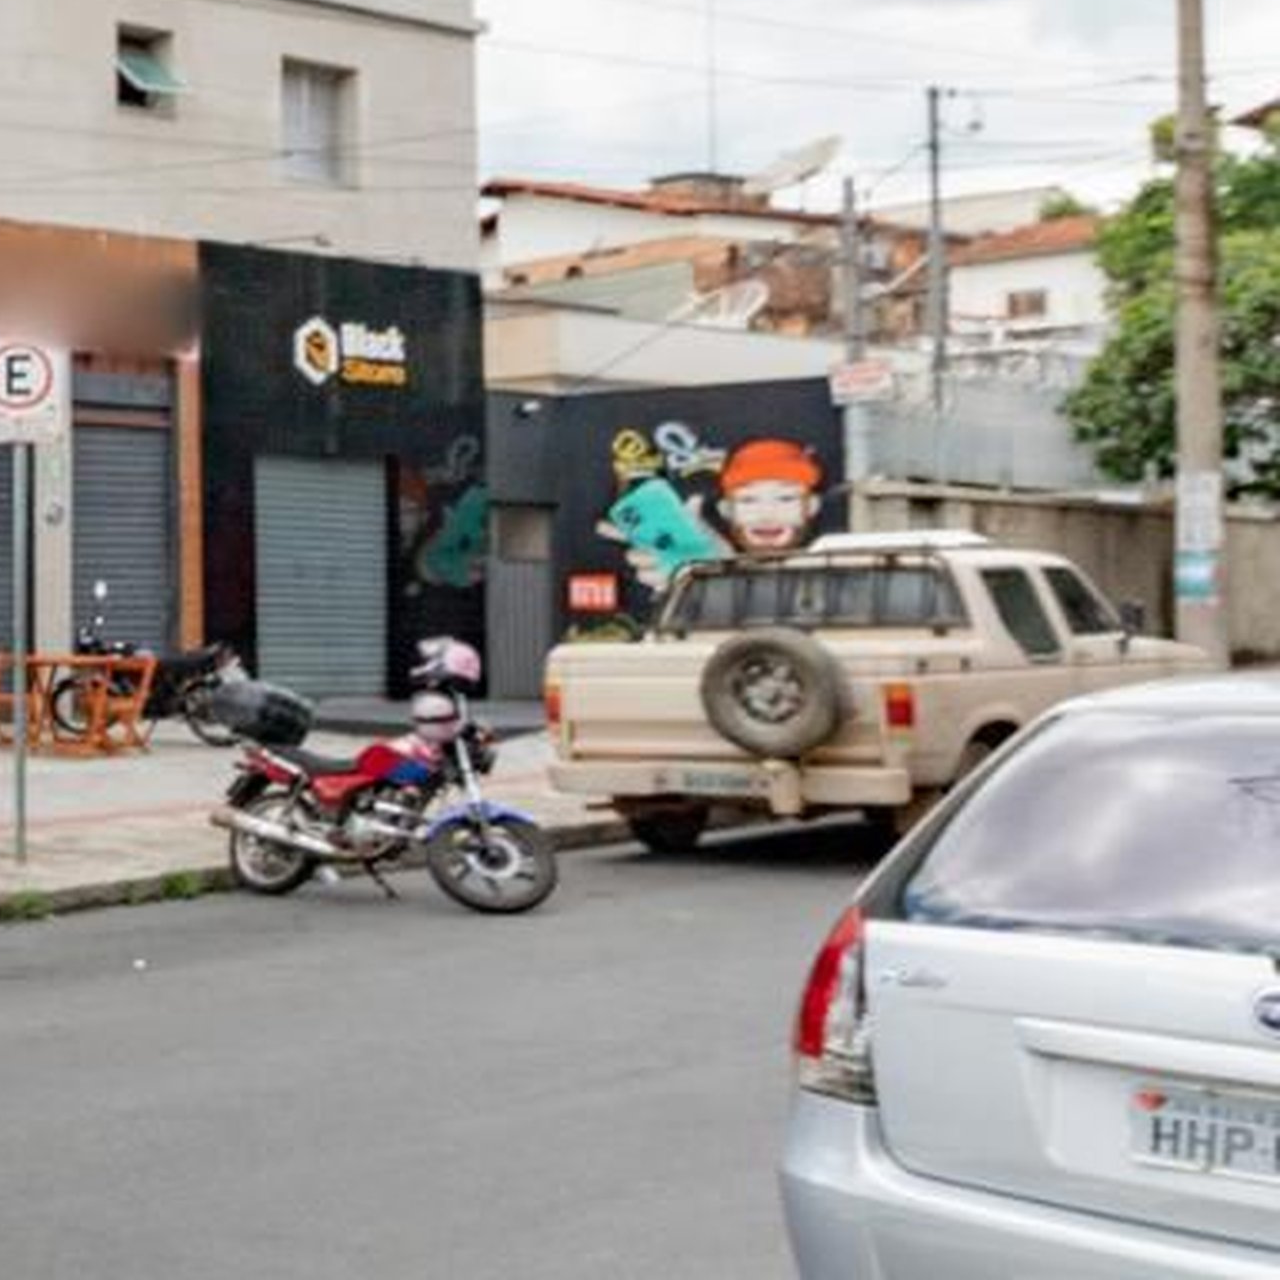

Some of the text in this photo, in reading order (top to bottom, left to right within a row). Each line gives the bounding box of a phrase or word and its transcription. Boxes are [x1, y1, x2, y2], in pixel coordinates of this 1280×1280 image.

[341, 323, 406, 359] Black
[5, 354, 31, 396] E
[1151, 1115, 1280, 1175] HHP-
